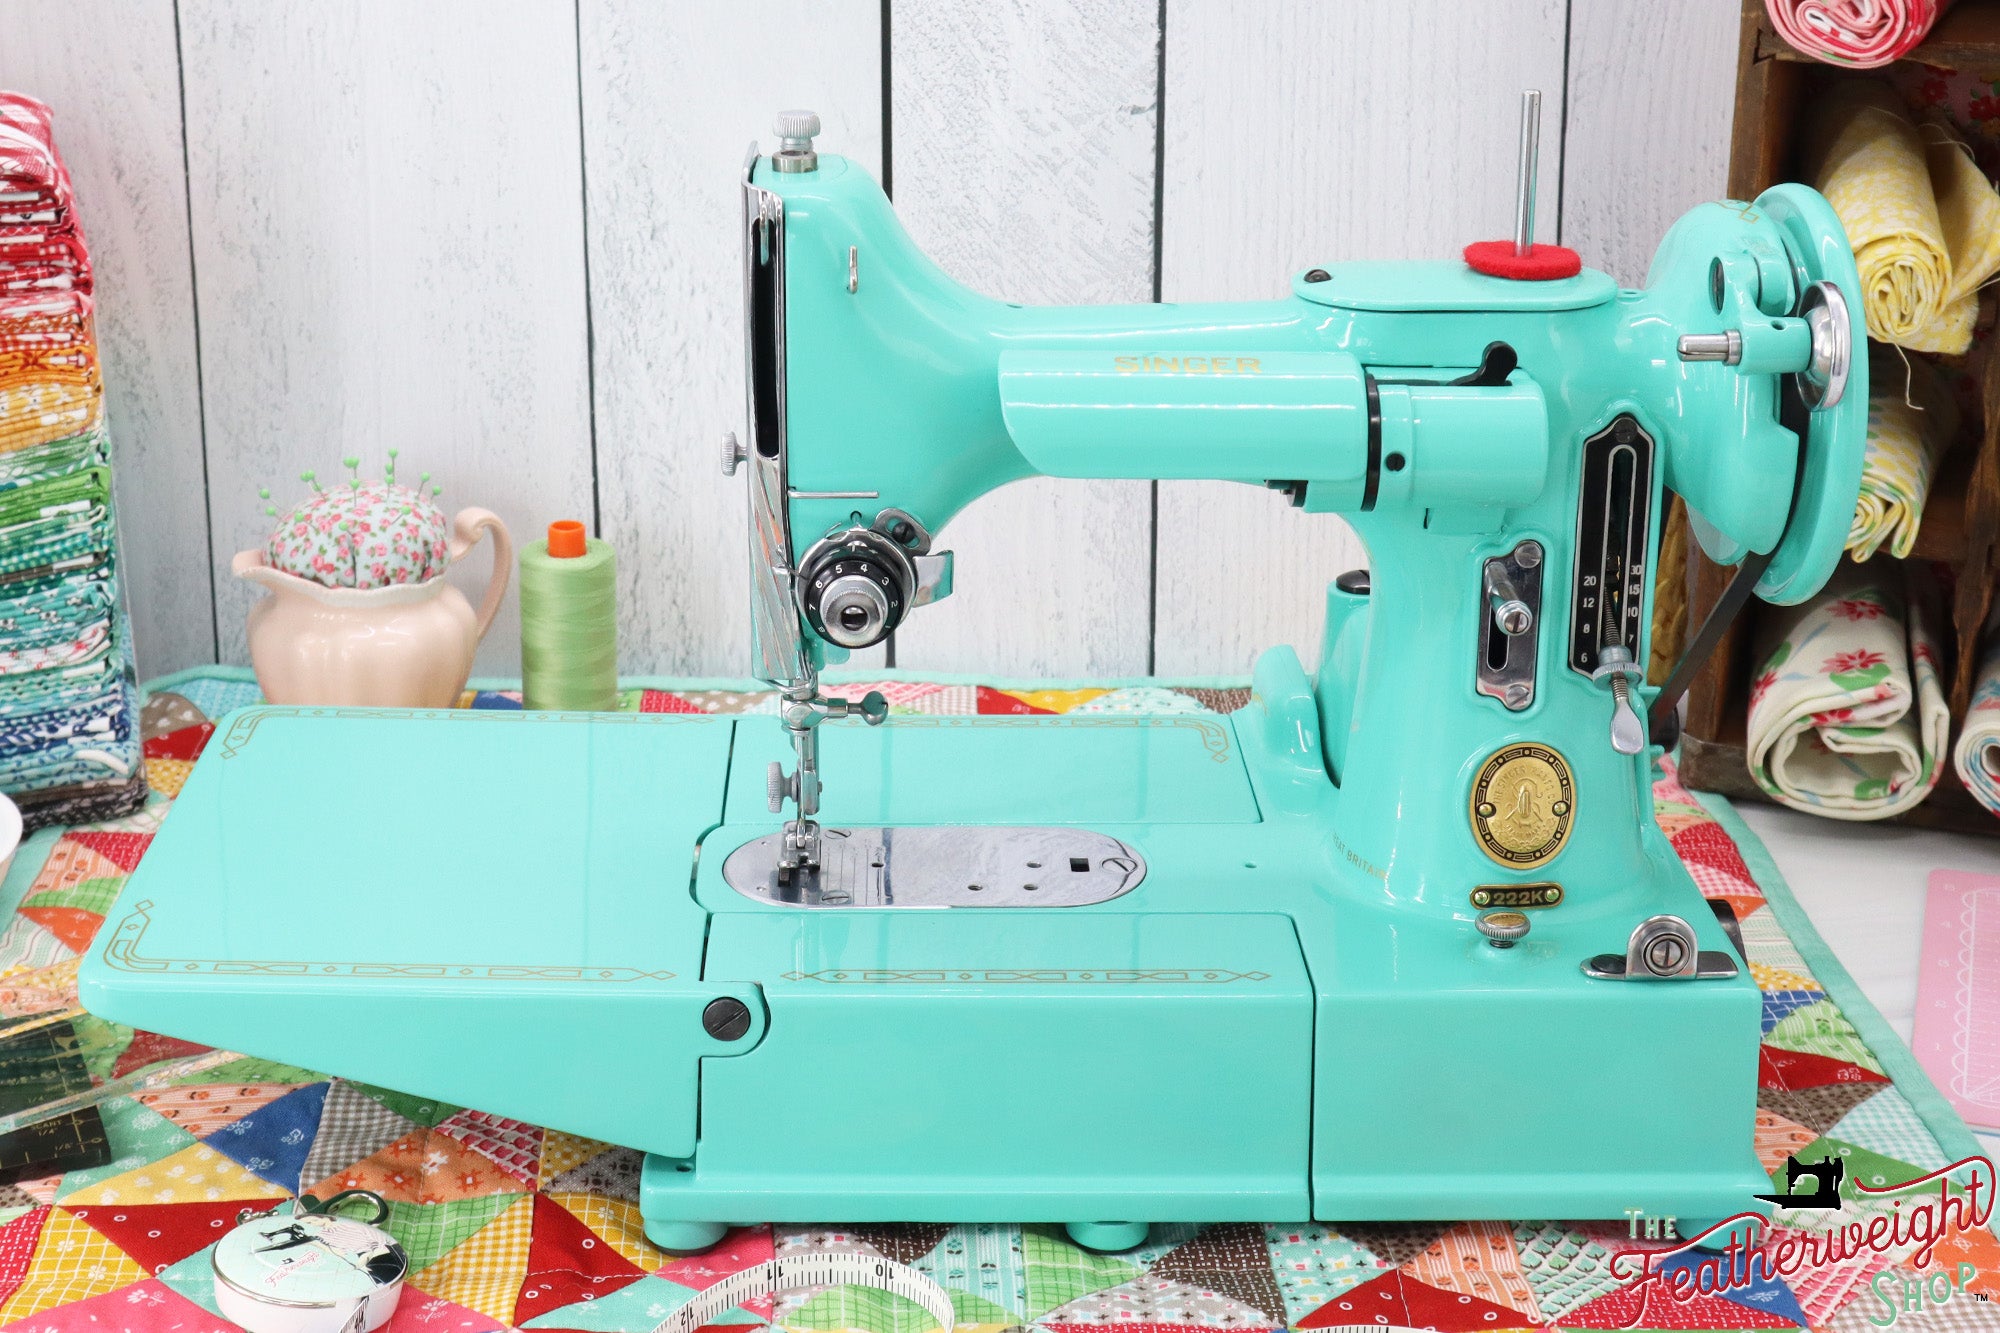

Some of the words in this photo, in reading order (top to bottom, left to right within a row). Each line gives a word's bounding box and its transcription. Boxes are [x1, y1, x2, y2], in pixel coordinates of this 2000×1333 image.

[1114, 356, 1263, 374] SINGER
[835, 564, 842, 573] 5
[860, 564, 868, 572] 4
[1630, 564, 1642, 576] 30
[815, 581, 823, 589] 6
[882, 577, 889, 586] 3
[1583, 575, 1597, 587] 20
[1628, 584, 1641, 596] 15
[809, 603, 817, 611] 7
[891, 600, 898, 608] 2
[1582, 597, 1595, 609] 12
[1627, 606, 1639, 618] 10
[1583, 623, 1591, 634] 8
[1629, 634, 1634, 644] 7
[1581, 652, 1588, 663] 6
[1493, 890, 1545, 905] 222K
